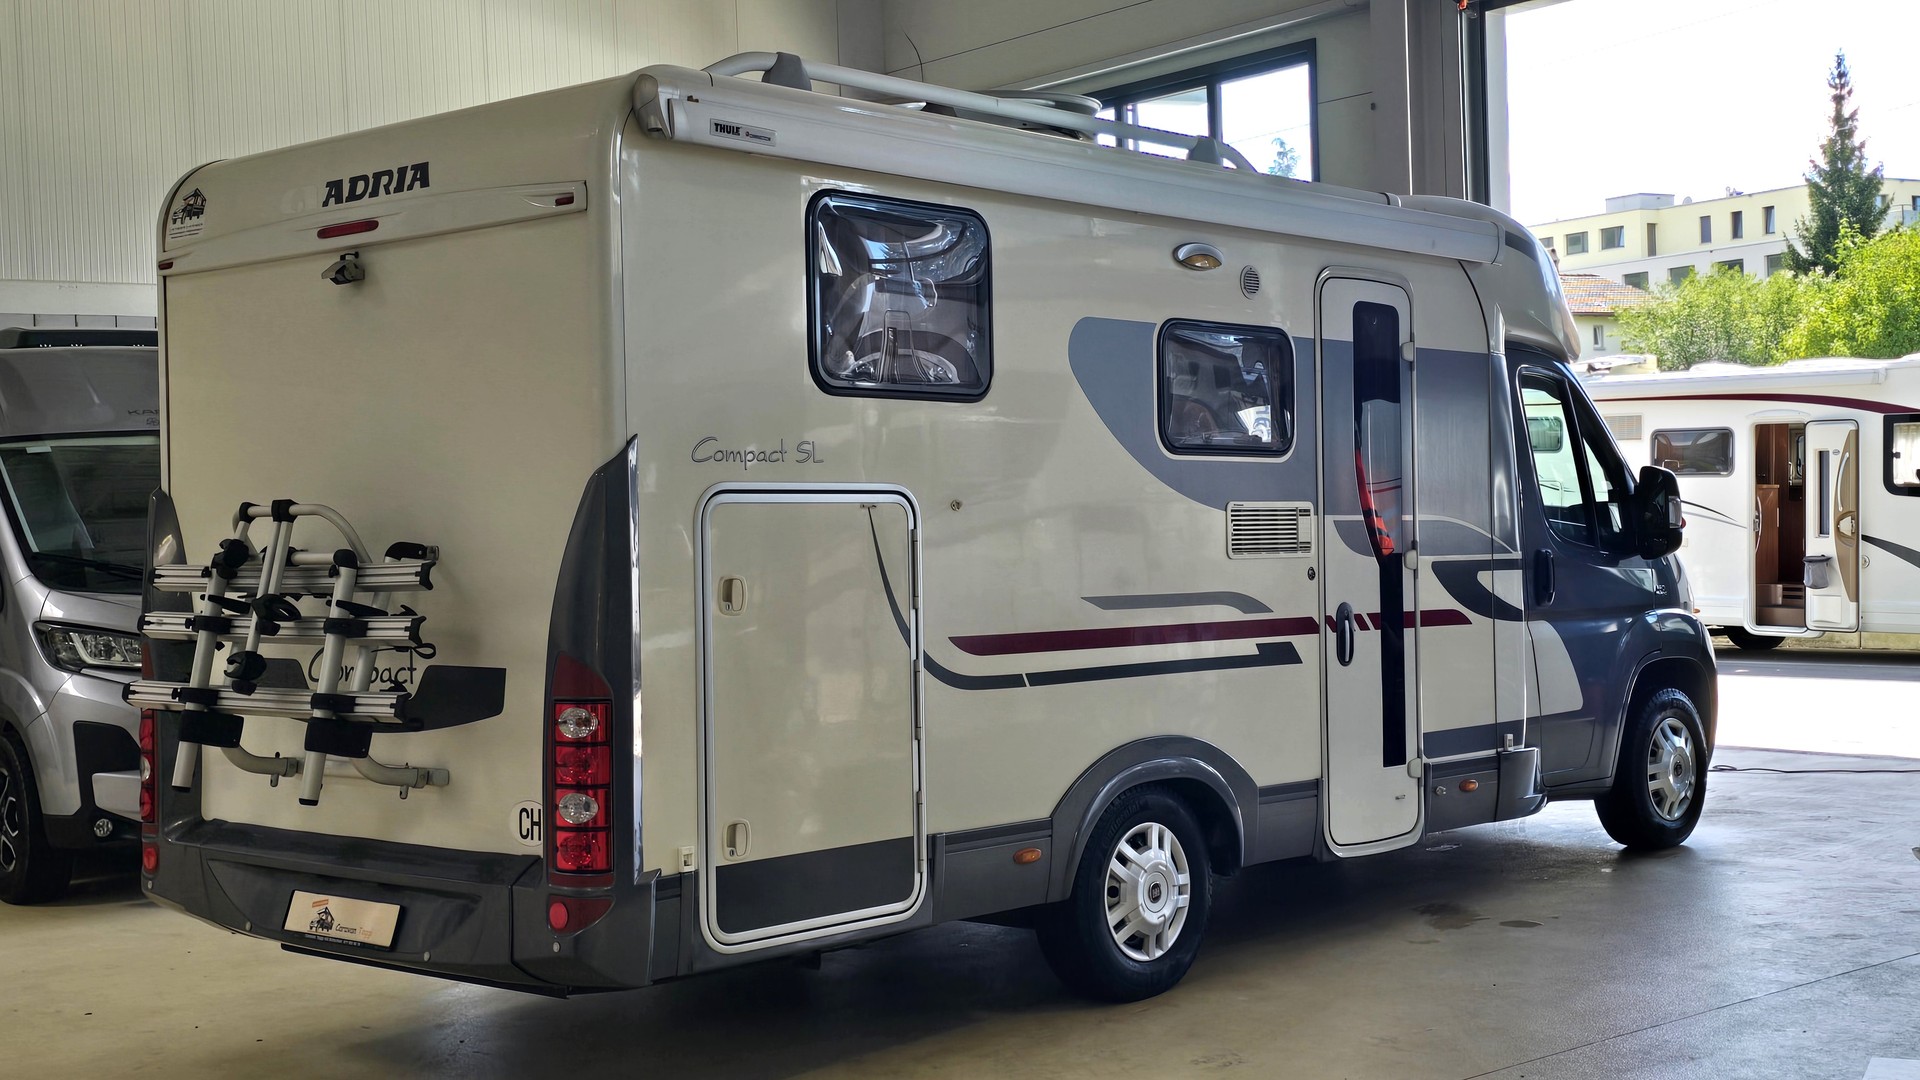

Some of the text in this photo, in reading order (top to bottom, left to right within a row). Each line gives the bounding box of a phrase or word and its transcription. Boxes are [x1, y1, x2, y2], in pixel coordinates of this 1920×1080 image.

[714, 122, 741, 136] THULE
[322, 161, 430, 207] ADRIA
[691, 436, 825, 471] Compact SL
[519, 807, 542, 842] CH
